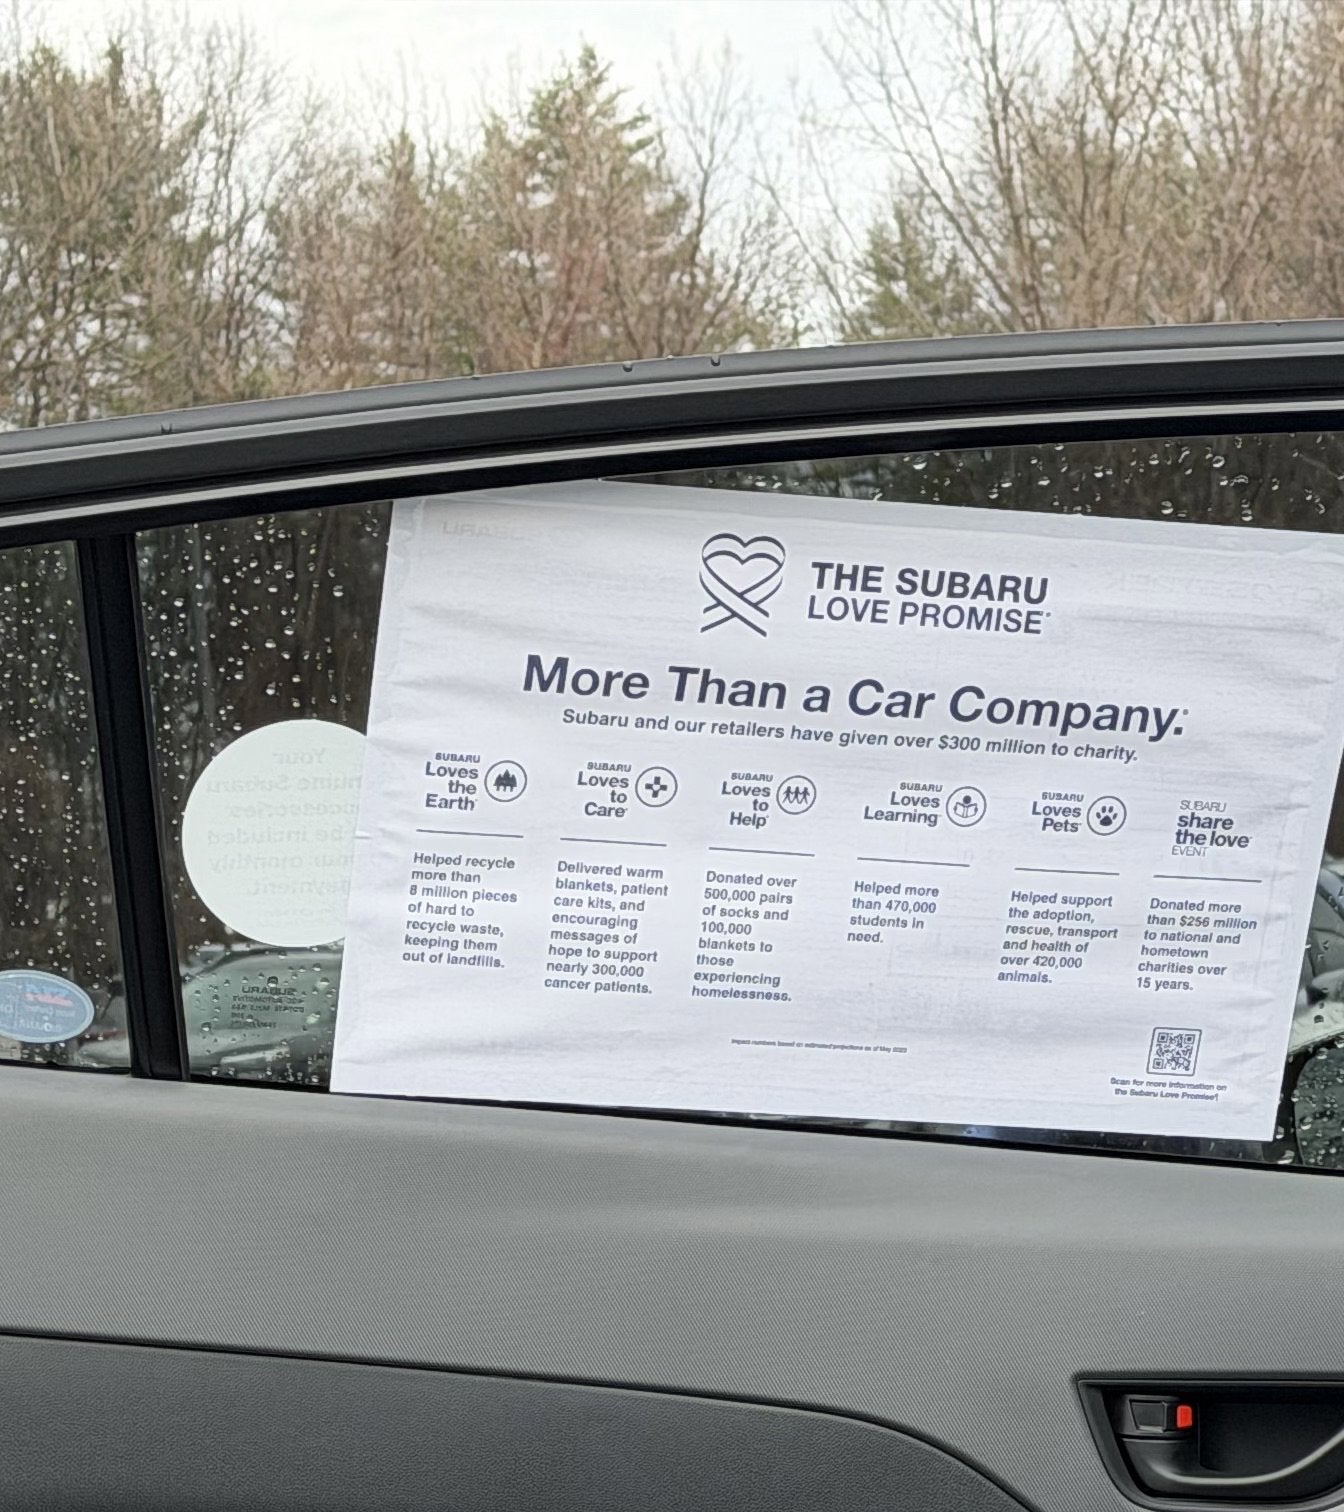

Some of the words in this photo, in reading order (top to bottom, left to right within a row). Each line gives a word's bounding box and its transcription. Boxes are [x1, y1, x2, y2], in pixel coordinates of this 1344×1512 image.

[811, 561, 884, 594] THE
[895, 567, 1048, 605] SUBARU
[808, 594, 890, 624] LOVE
[898, 601, 1050, 635] PROMISE
[523, 654, 650, 700] More
[668, 665, 787, 710] Than
[802, 685, 831, 713] a
[848, 678, 936, 719] Car
[949, 685, 1184, 741] Company.
[562, 708, 629, 728] Subaru
[634, 715, 670, 730] and
[674, 720, 706, 733] our
[710, 721, 784, 738] retailers
[790, 725, 834, 742] have
[838, 729, 888, 747] given
[894, 735, 934, 748] over
[938, 734, 981, 751] $300
[985, 738, 1046, 755] million
[1051, 742, 1069, 756] to
[1074, 744, 1138, 764] charity.
[435, 752, 480, 764] SUBARU
[425, 761, 479, 780] Loves
[587, 762, 632, 772] SUBARU
[577, 770, 629, 789] Loves
[730, 772, 774, 782] SUBARU
[448, 780, 477, 795] the
[721, 780, 771, 800] Loves
[900, 782, 943, 792] SUBARU
[425, 792, 478, 810] Earth
[610, 790, 628, 804] to
[752, 798, 770, 812] to
[890, 791, 940, 810] Loves
[1042, 792, 1084, 802] SUBARU
[584, 801, 628, 818] Care
[1032, 801, 1082, 820] Loves
[1180, 800, 1227, 813] SUBARU
[729, 810, 770, 828] Help
[864, 805, 941, 828] Learning
[1177, 812, 1234, 830] share
[1042, 817, 1082, 833] Pets
[1175, 830, 1208, 845] the
[1209, 831, 1252, 848] love
[1171, 844, 1208, 857] EVENT
[413, 852, 462, 868] Helped
[465, 856, 515, 870] recycle
[411, 870, 447, 881] more
[451, 870, 481, 884] than
[557, 860, 622, 876] Delivered
[626, 868, 664, 879] warm
[555, 877, 617, 895] blankets,
[620, 883, 668, 896] patient
[706, 870, 764, 886] Donated
[766, 877, 798, 888] over
[409, 884, 418, 896] 8
[422, 885, 468, 899] million
[472, 889, 517, 903] pieces
[704, 887, 756, 902] 500,000
[758, 892, 793, 906] pairs
[854, 880, 902, 896] Helped
[904, 886, 940, 898] more
[554, 896, 584, 908] care
[588, 896, 616, 912] kits,
[619, 900, 646, 912] and
[852, 897, 882, 910] than
[885, 899, 936, 914] 470,000
[1011, 890, 1058, 906] Helped
[1060, 896, 1113, 908] support
[1150, 898, 1205, 912] Donated
[1208, 903, 1242, 914] more
[408, 901, 422, 913] of
[425, 902, 457, 916] hard
[461, 905, 475, 917] to
[702, 904, 717, 916] of
[720, 907, 760, 919] socks
[763, 909, 790, 921] and
[1008, 907, 1030, 918] the
[1032, 908, 1094, 924] adoption,
[406, 920, 456, 934] recycle
[460, 924, 504, 938] waste,
[552, 913, 638, 930] encouraging
[701, 921, 752, 936] 100,000
[850, 914, 908, 928] students
[912, 917, 924, 929] in
[1147, 914, 1176, 926] than
[1179, 915, 1210, 928] $256
[1211, 917, 1258, 930] million
[550, 930, 620, 945] messages
[623, 932, 638, 944] of
[847, 931, 884, 943] need.
[1006, 924, 1054, 937] rescue,
[1056, 926, 1118, 941] transport
[1144, 929, 1157, 941] to
[1160, 931, 1214, 943] national
[1216, 933, 1242, 944] and
[404, 934, 460, 952] keeping
[463, 938, 498, 952] them
[698, 937, 756, 952] blankets
[760, 941, 773, 953] to
[1002, 939, 1028, 950] and
[1030, 940, 1074, 953] health
[1075, 942, 1090, 952] of
[548, 944, 583, 959] hope
[586, 946, 600, 958] to
[604, 950, 658, 963] support
[1140, 944, 1208, 959] hometown
[402, 952, 425, 963] out
[428, 952, 444, 964] of
[446, 952, 505, 968] landfills.
[696, 954, 734, 966] those
[1000, 956, 1030, 966] over
[1032, 955, 1082, 972] 420,000
[1138, 960, 1194, 974] charities
[1198, 966, 1228, 976] over
[546, 962, 588, 976] nearly
[592, 963, 644, 978] 300,000
[997, 970, 1052, 984] animals.
[544, 978, 591, 990] cancer
[594, 981, 652, 994] patients.
[694, 972, 781, 988] experiencing
[1137, 976, 1151, 988] 15
[1154, 980, 1194, 992] years.
[692, 985, 792, 1002] homelessness.
[1111, 1077, 1130, 1086] Scan
[1146, 1080, 1167, 1088] more
[1169, 1080, 1214, 1091] information
[1115, 1088, 1127, 1096] the
[1130, 1088, 1158, 1098] Subaru
[1160, 1089, 1179, 1099] Love
